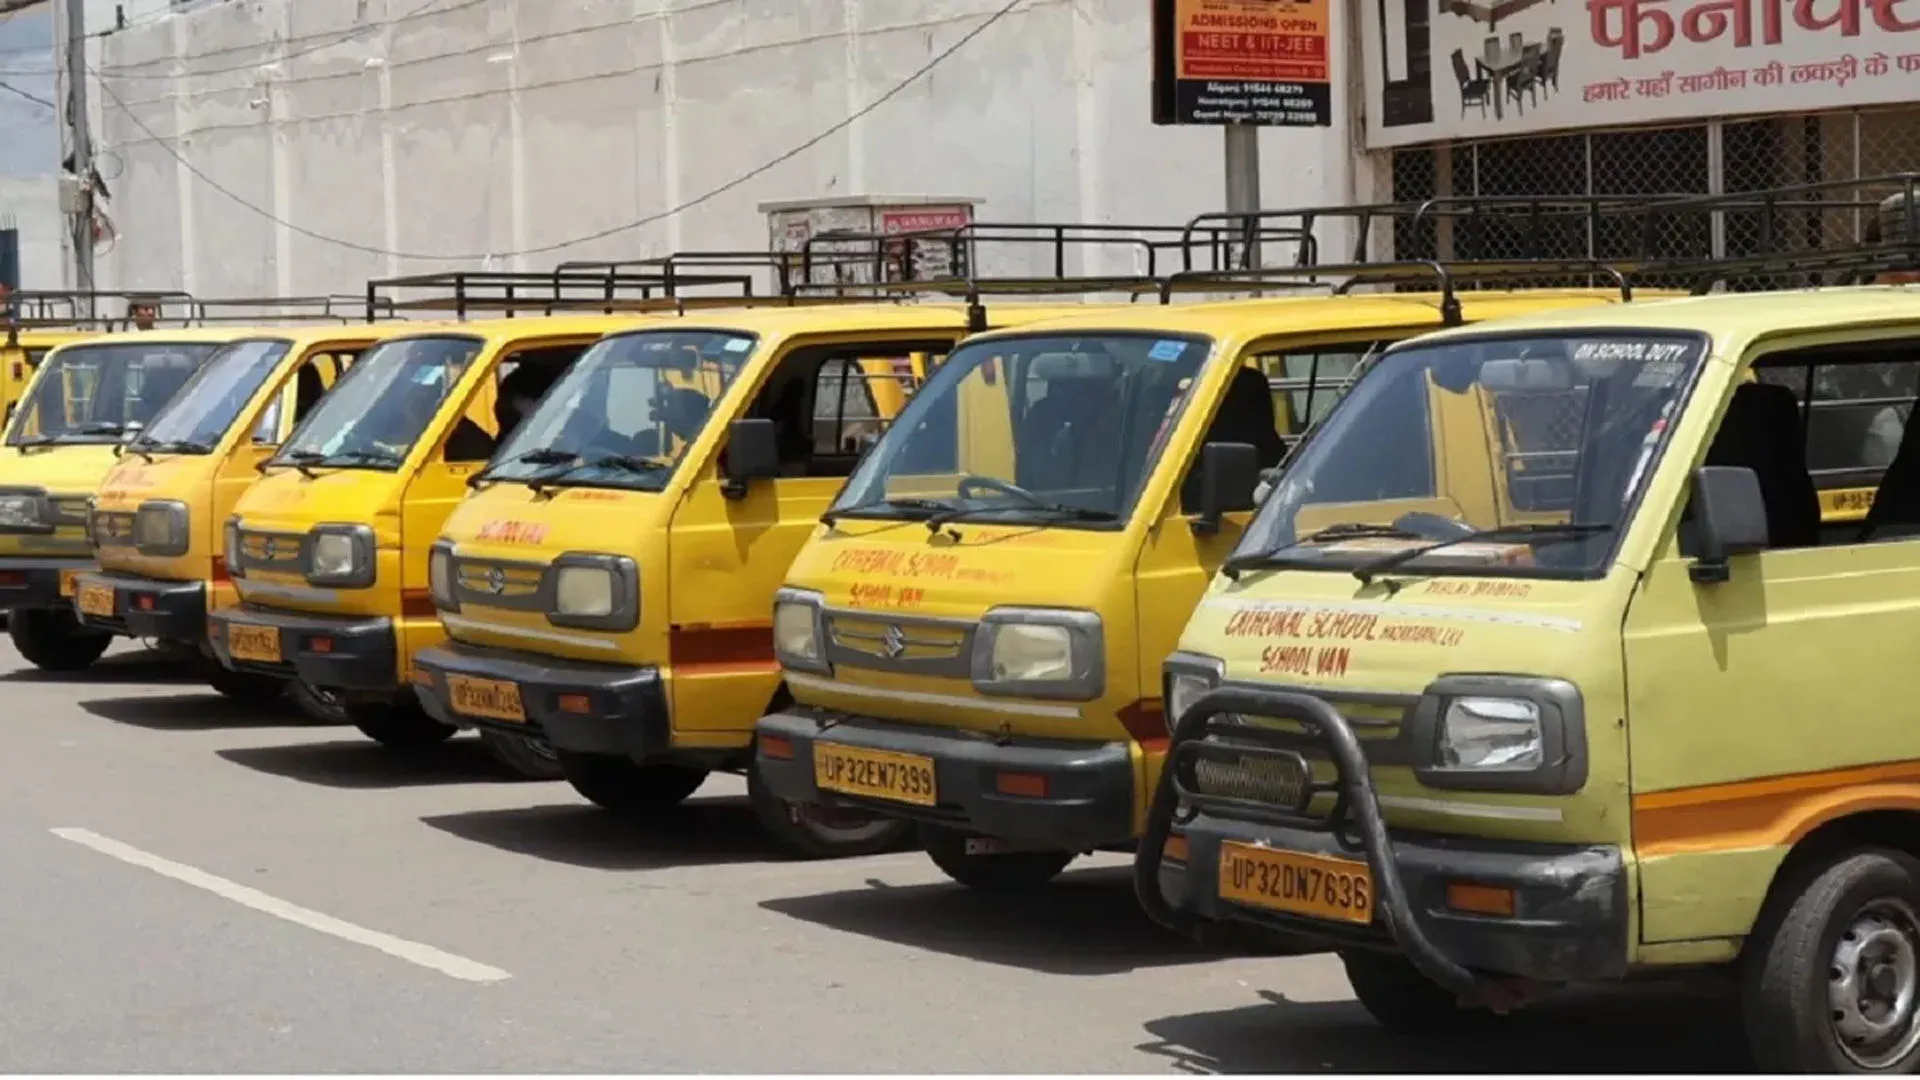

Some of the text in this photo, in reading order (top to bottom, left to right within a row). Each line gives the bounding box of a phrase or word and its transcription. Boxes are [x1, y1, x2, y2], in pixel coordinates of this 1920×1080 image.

[1191, 13, 1317, 32] ADMISSIONS OPEN
[1198, 34, 1314, 51] NEET & IIT-JEE
[1583, 77, 1630, 102] हमारे
[1752, 60, 1784, 87] की
[1864, 52, 1888, 77] के
[1592, 343, 1647, 361] SCHOOL
[1646, 344, 1689, 361] DUTY
[1225, 608, 1306, 638] CATHEDRAL
[1307, 610, 1379, 641] SCHOOL
[1260, 645, 1352, 679] SCHOOL VAN
[824, 752, 932, 796] UP32EN7399
[1232, 857, 1367, 911] UP32DN7636
